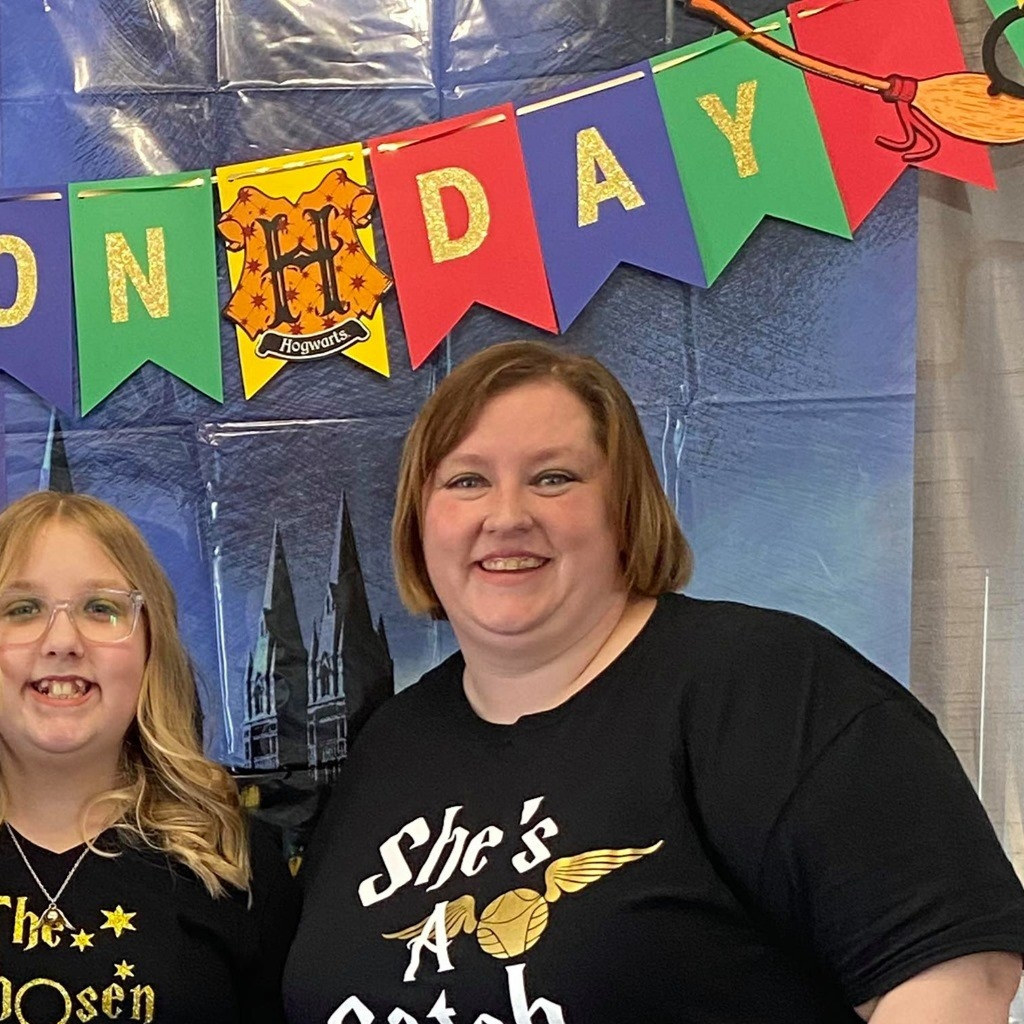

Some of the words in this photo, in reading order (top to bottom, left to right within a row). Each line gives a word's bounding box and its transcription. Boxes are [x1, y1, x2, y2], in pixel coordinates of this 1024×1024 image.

[414, 80, 759, 264] DAY
[279, 327, 350, 355] Hogwarts
[357, 795, 559, 908] She's
[402, 900, 455, 982] A
